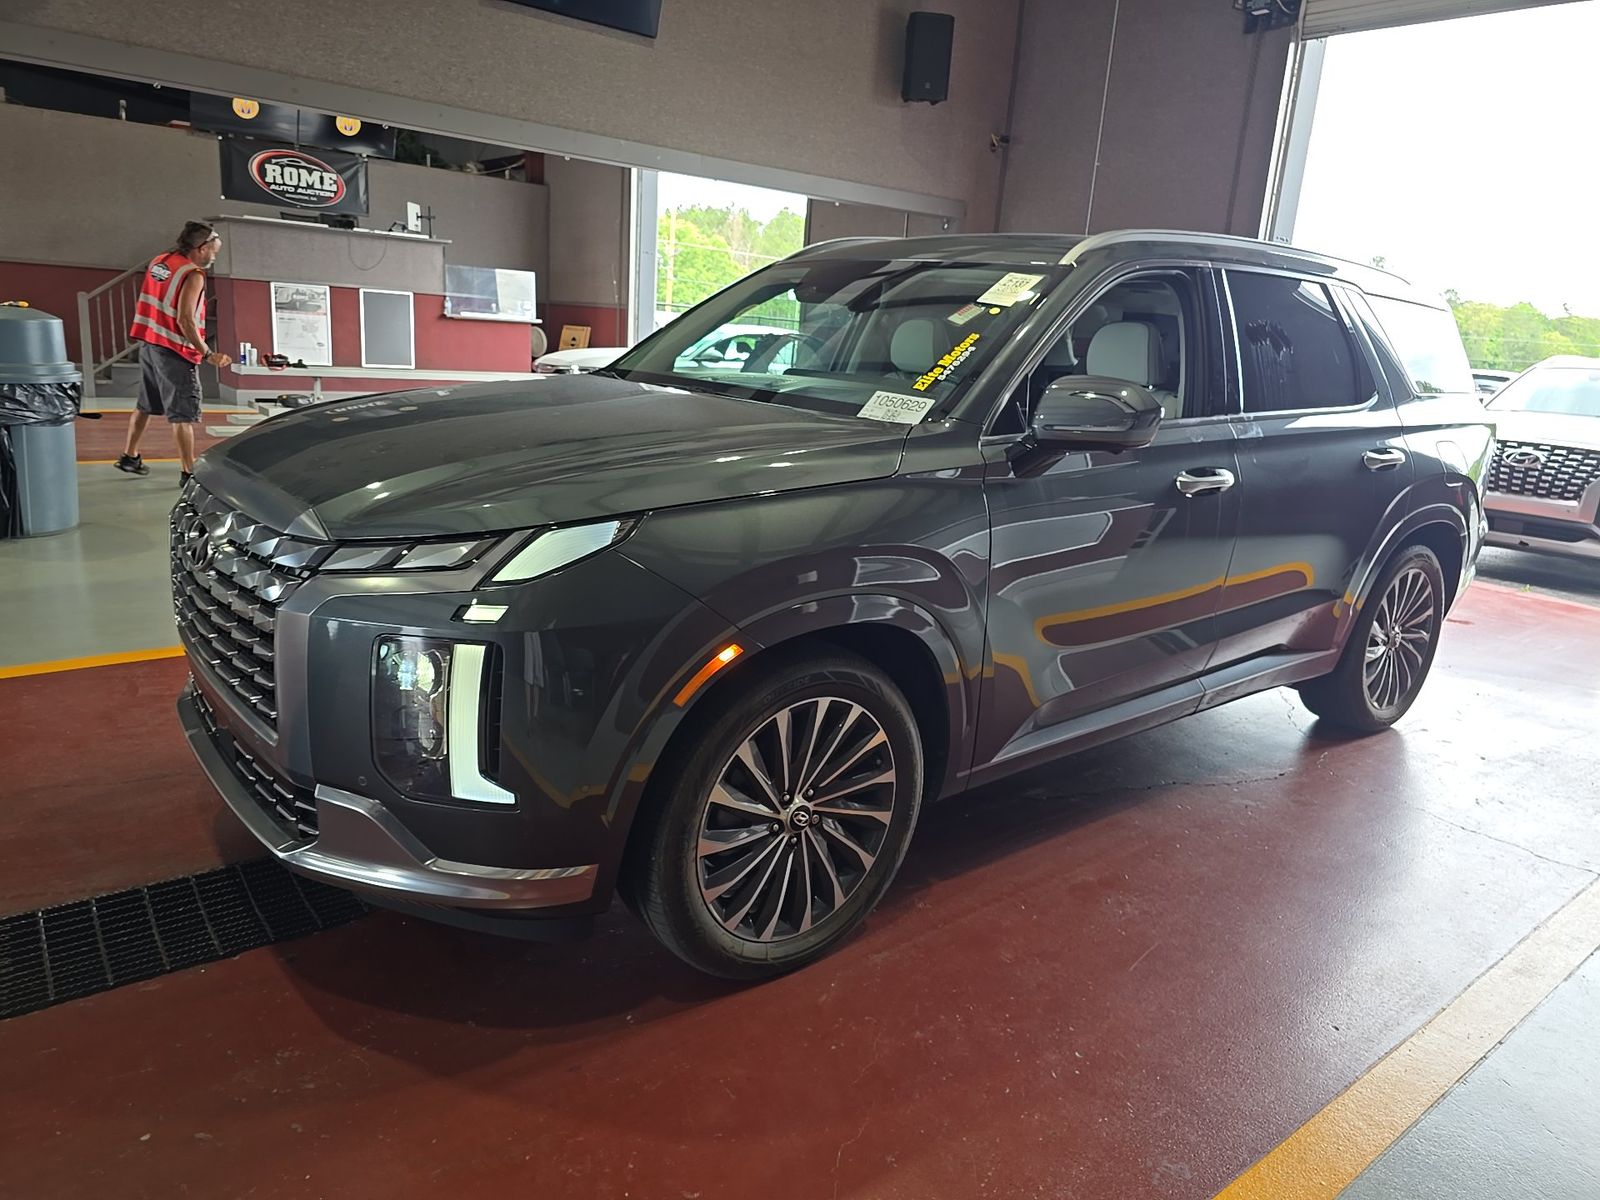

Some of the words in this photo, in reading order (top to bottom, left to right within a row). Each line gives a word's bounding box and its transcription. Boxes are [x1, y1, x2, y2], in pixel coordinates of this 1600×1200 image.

[265, 163, 337, 192] ROME
[270, 184, 295, 192] AUTO
[296, 187, 335, 197] AUCTION
[912, 367, 944, 391] Elite
[937, 332, 980, 367] Motors
[874, 394, 927, 413] 1050629
